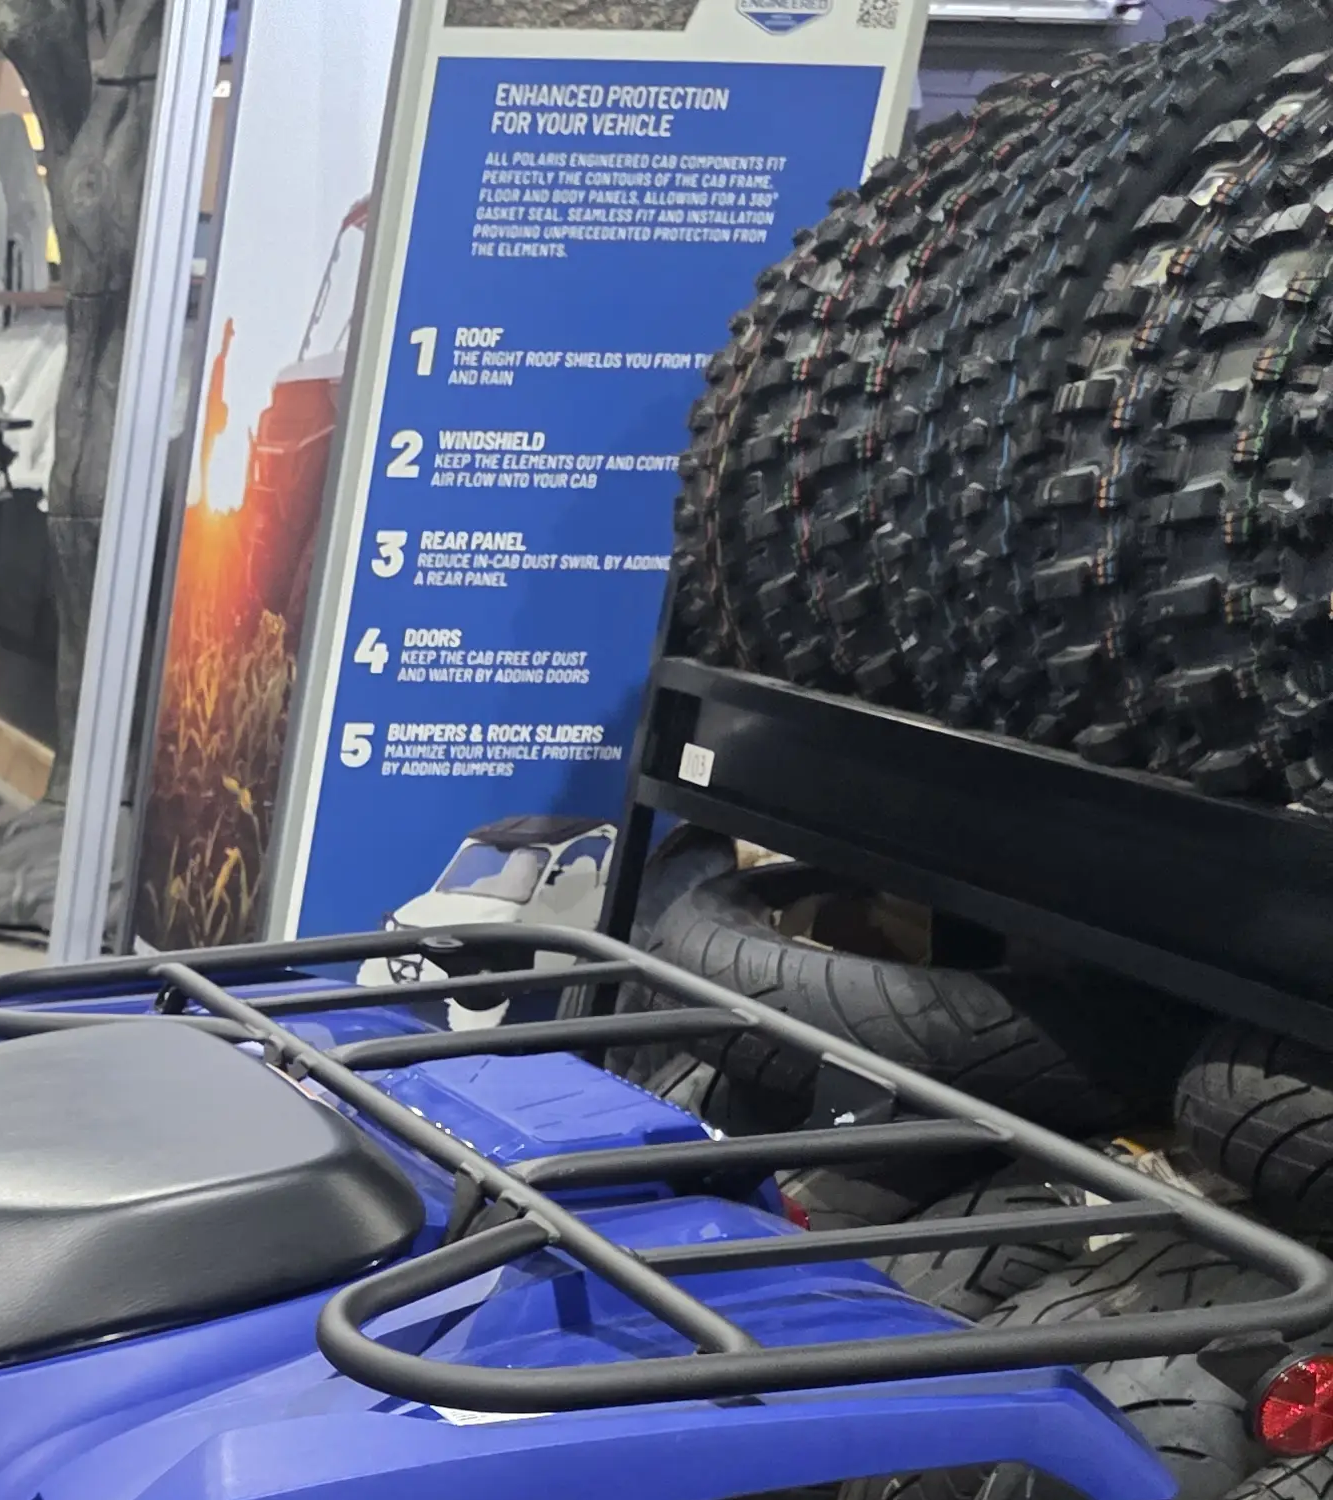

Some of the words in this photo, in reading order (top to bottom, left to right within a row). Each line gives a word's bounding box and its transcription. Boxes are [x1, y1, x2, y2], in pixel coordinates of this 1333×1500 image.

[495, 83, 605, 108] ENHANCED
[607, 86, 730, 110] PROTECTION
[491, 111, 531, 135] FOR
[536, 112, 587, 135] YOUR
[592, 113, 674, 137] VEHICLE
[485, 152, 508, 167] ALL
[512, 152, 567, 167] POLARIS
[569, 153, 649, 169] ENGINEERED
[651, 154, 678, 169] CAB
[680, 155, 764, 171] COMPONENTS
[766, 157, 787, 171] FIT
[482, 170, 555, 185] PERFECTLY
[558, 171, 582, 185] THE
[585, 171, 652, 187] CONTOURS
[655, 173, 672, 187] OF
[675, 173, 700, 188] THE
[701, 174, 727, 188] CAB
[479, 188, 521, 202] FLOOR
[522, 189, 550, 203] AND
[644, 191, 708, 205] ALLOWING
[711, 192, 736, 206] FOR
[737, 193, 746, 206] A
[476, 206, 525, 220] GASKET
[567, 207, 632, 222] SEAMLESS
[635, 209, 656, 222] FIT
[658, 209, 685, 223] AND
[687, 210, 774, 225] INSTALLATION
[473, 224, 541, 238] PROVIDING
[543, 225, 651, 241] UNPRECEDENTED
[654, 227, 731, 242] PROTECTION
[734, 229, 767, 243] FROM
[471, 242, 495, 256] THE
[455, 327, 505, 348] ROOF
[410, 326, 438, 376] 1
[453, 350, 480, 366] THE
[482, 351, 524, 367] RIGHT
[525, 352, 561, 367] ROOF
[565, 352, 622, 368] SHIELDS
[625, 354, 652, 369] YOU
[654, 354, 691, 369] FROM
[448, 370, 478, 386] AND
[480, 371, 514, 386] RAIN
[438, 431, 545, 451] WINDSHIELD
[386, 430, 424, 478] 2
[434, 453, 470, 469] KEEP
[475, 454, 500, 469] THE
[502, 454, 574, 471] ELEMENTS
[577, 455, 602, 471] OUT
[605, 455, 634, 471] AND
[430, 474, 456, 488] AIR
[457, 474, 496, 488] FLOW
[498, 475, 529, 488] INTO
[533, 475, 568, 489] YOUR
[570, 475, 597, 489] CAB
[420, 531, 467, 551] REAR
[471, 532, 527, 552] PANEL
[371, 530, 408, 578] 3
[417, 553, 471, 569] REDUCE
[474, 553, 520, 570] IN-CAB
[522, 554, 557, 570] DUST
[560, 554, 600, 570] SWIRL
[604, 555, 622, 571] BY
[413, 572, 424, 586] A
[426, 572, 462, 586] REAR
[465, 572, 508, 588] PANEL
[404, 628, 462, 648] DOORS
[354, 628, 389, 674] 4
[401, 651, 436, 665] KEEP
[439, 651, 464, 665] THE
[467, 651, 494, 665] CAB
[496, 651, 530, 666] FREE
[533, 652, 550, 666] OF
[552, 652, 588, 666] DUST
[397, 668, 426, 682] AND
[429, 668, 473, 683] WATER
[475, 669, 493, 683] BY
[494, 669, 544, 683] ADDING
[546, 669, 590, 684] DOORS
[387, 723, 467, 742] BUMPERS
[470, 724, 483, 742] &
[487, 724, 533, 743] ROCK
[535, 725, 605, 744] SLIDERS
[340, 722, 375, 768] 5
[384, 744, 446, 760] MAXIMIZE
[449, 745, 483, 760] YOUR
[486, 745, 540, 761] VEHICLE
[542, 745, 622, 761] PROTECTION
[381, 761, 400, 776] BY
[401, 761, 451, 777] ADDING
[452, 762, 515, 777] BUMPERS
